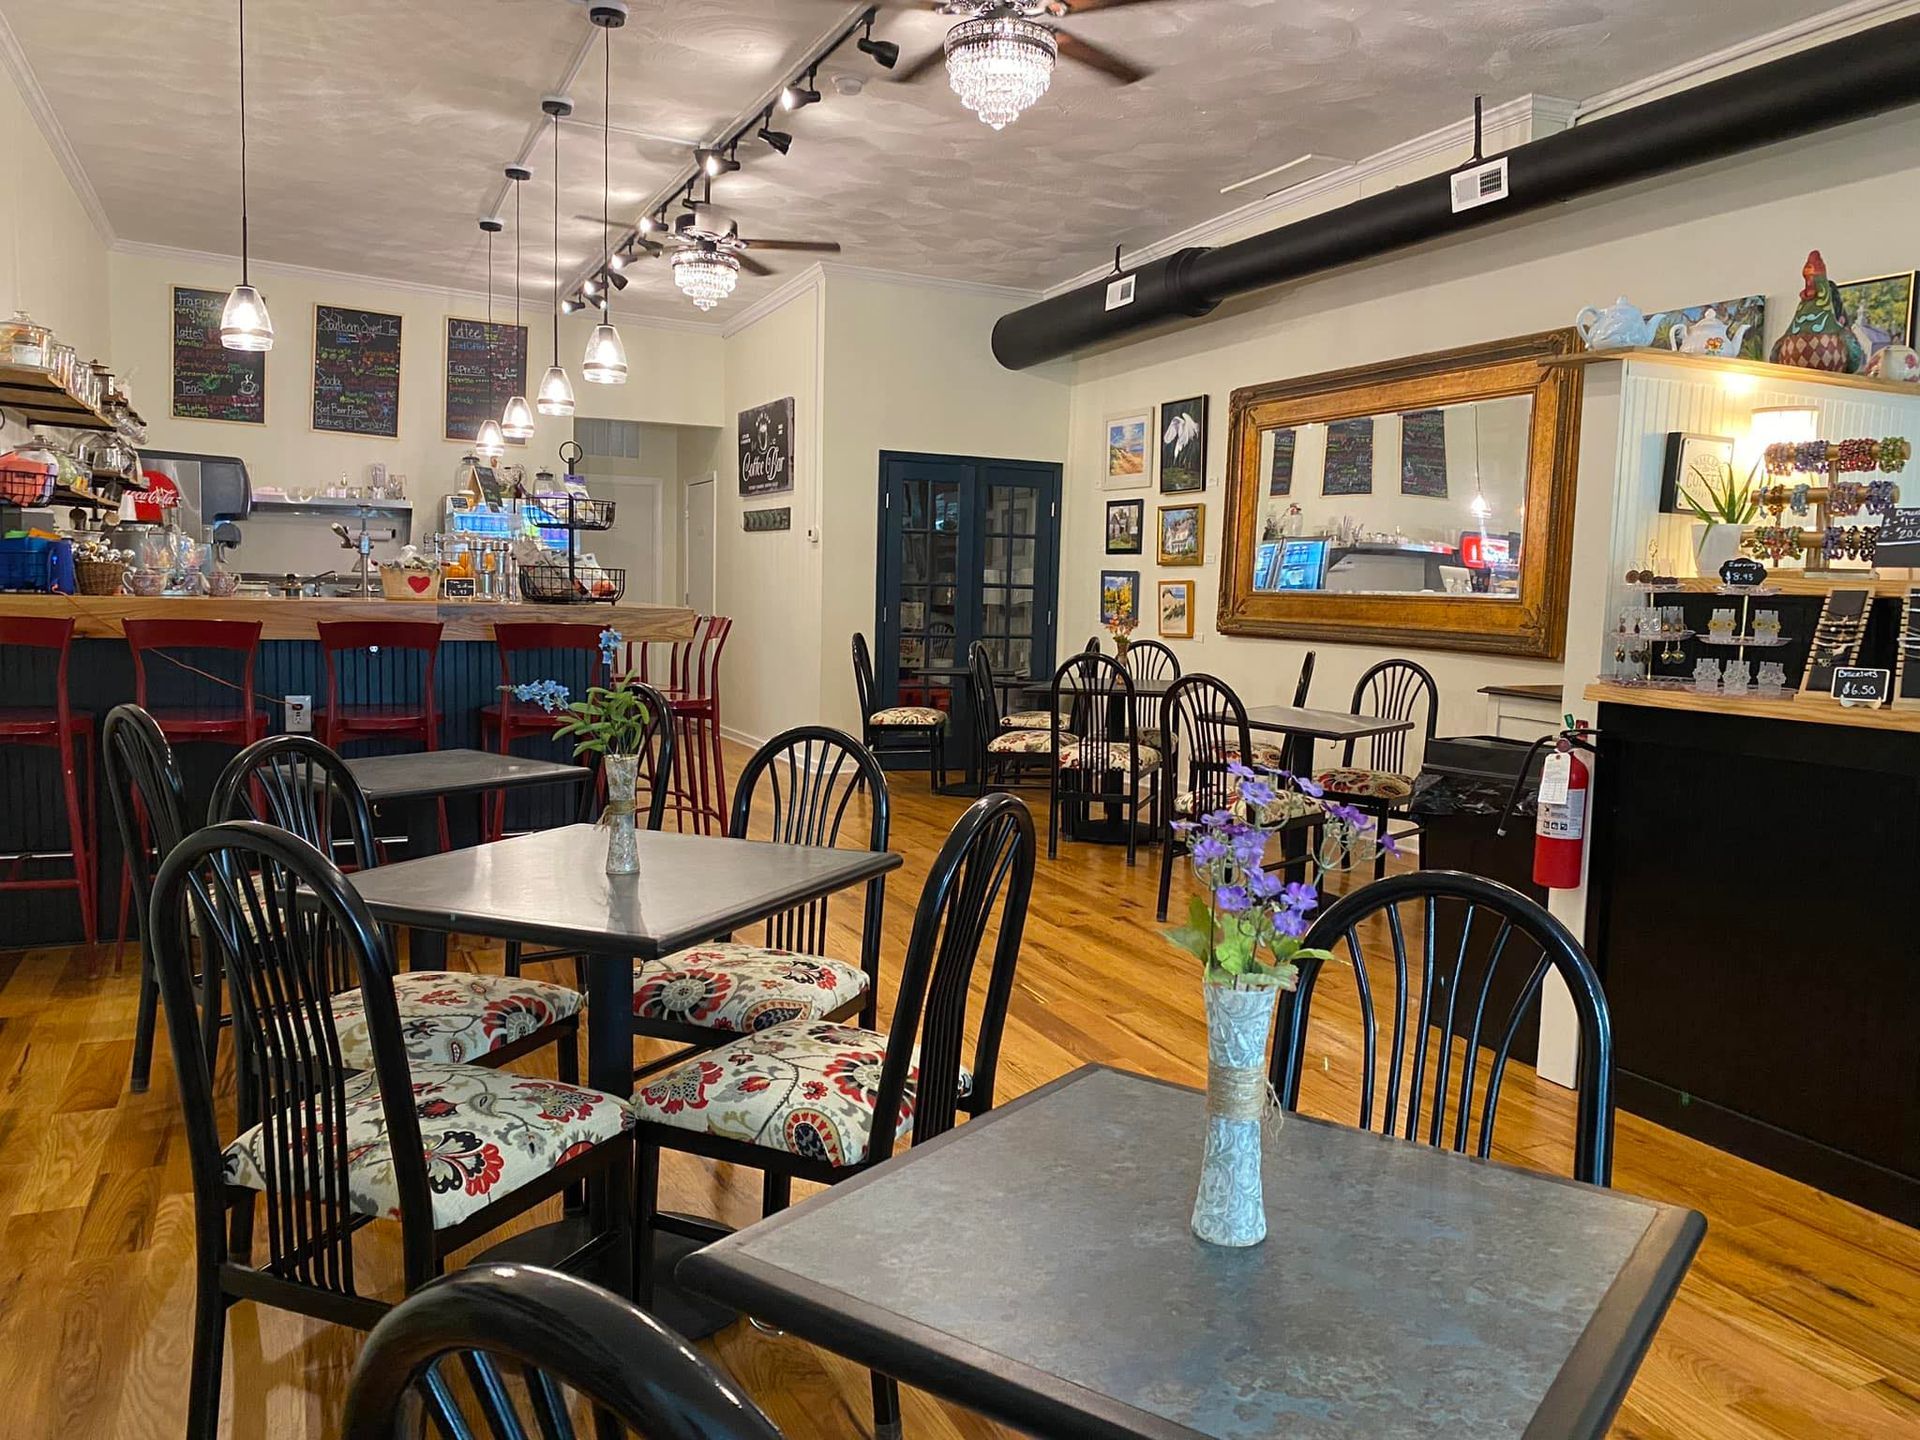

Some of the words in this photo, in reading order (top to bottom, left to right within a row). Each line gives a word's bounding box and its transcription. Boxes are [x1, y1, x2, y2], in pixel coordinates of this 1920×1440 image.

[450, 320, 482, 338] Coffee
[449, 361, 486, 376] Espresso
[176, 380, 204, 395] Teas
[1842, 681, 1876, 696] $6.50
